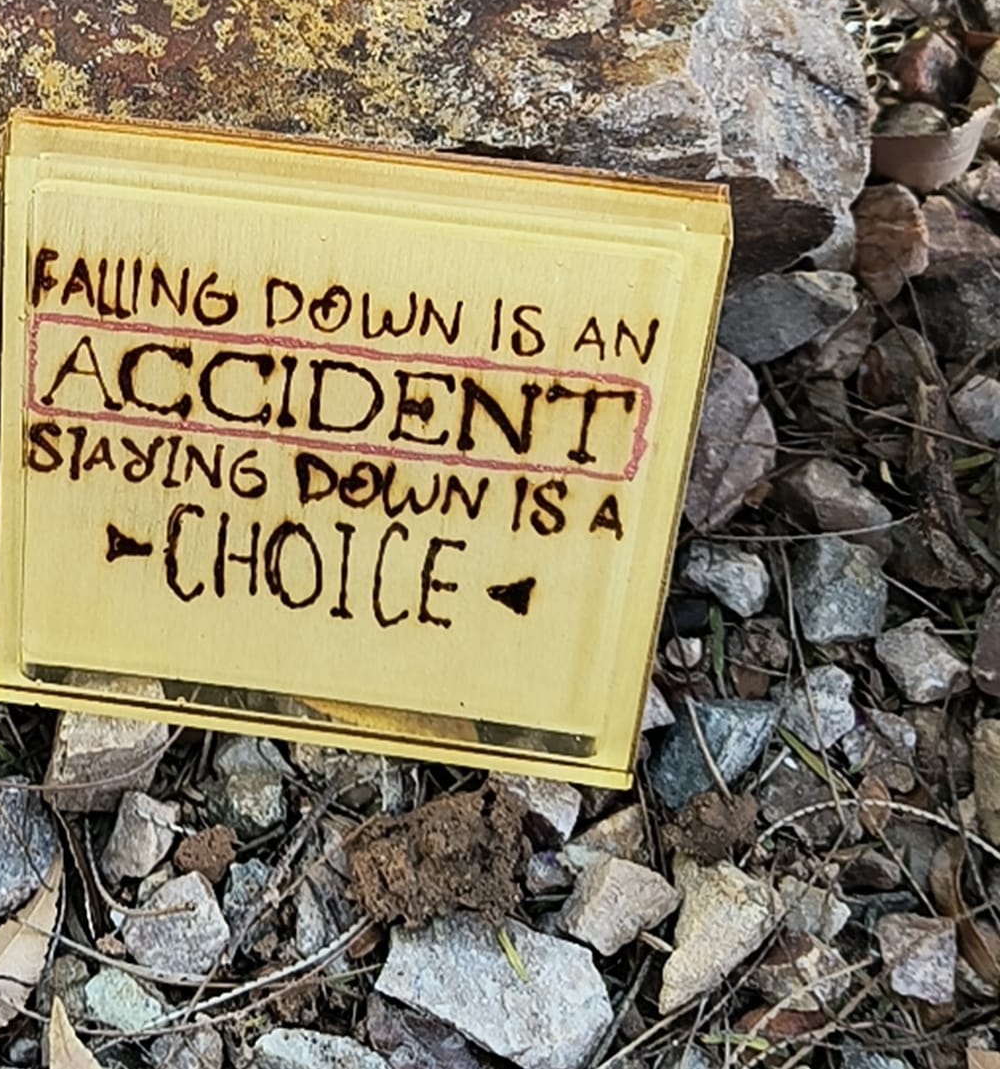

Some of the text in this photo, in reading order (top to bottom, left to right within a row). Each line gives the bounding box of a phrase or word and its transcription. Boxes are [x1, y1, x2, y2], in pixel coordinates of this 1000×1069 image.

[29, 247, 661, 365] FALLING DOWN IS AN
[41, 335, 636, 465] ACCIDENT
[27, 421, 625, 540] STAYING DOWN IS A
[163, 503, 467, 629] CHOICE
